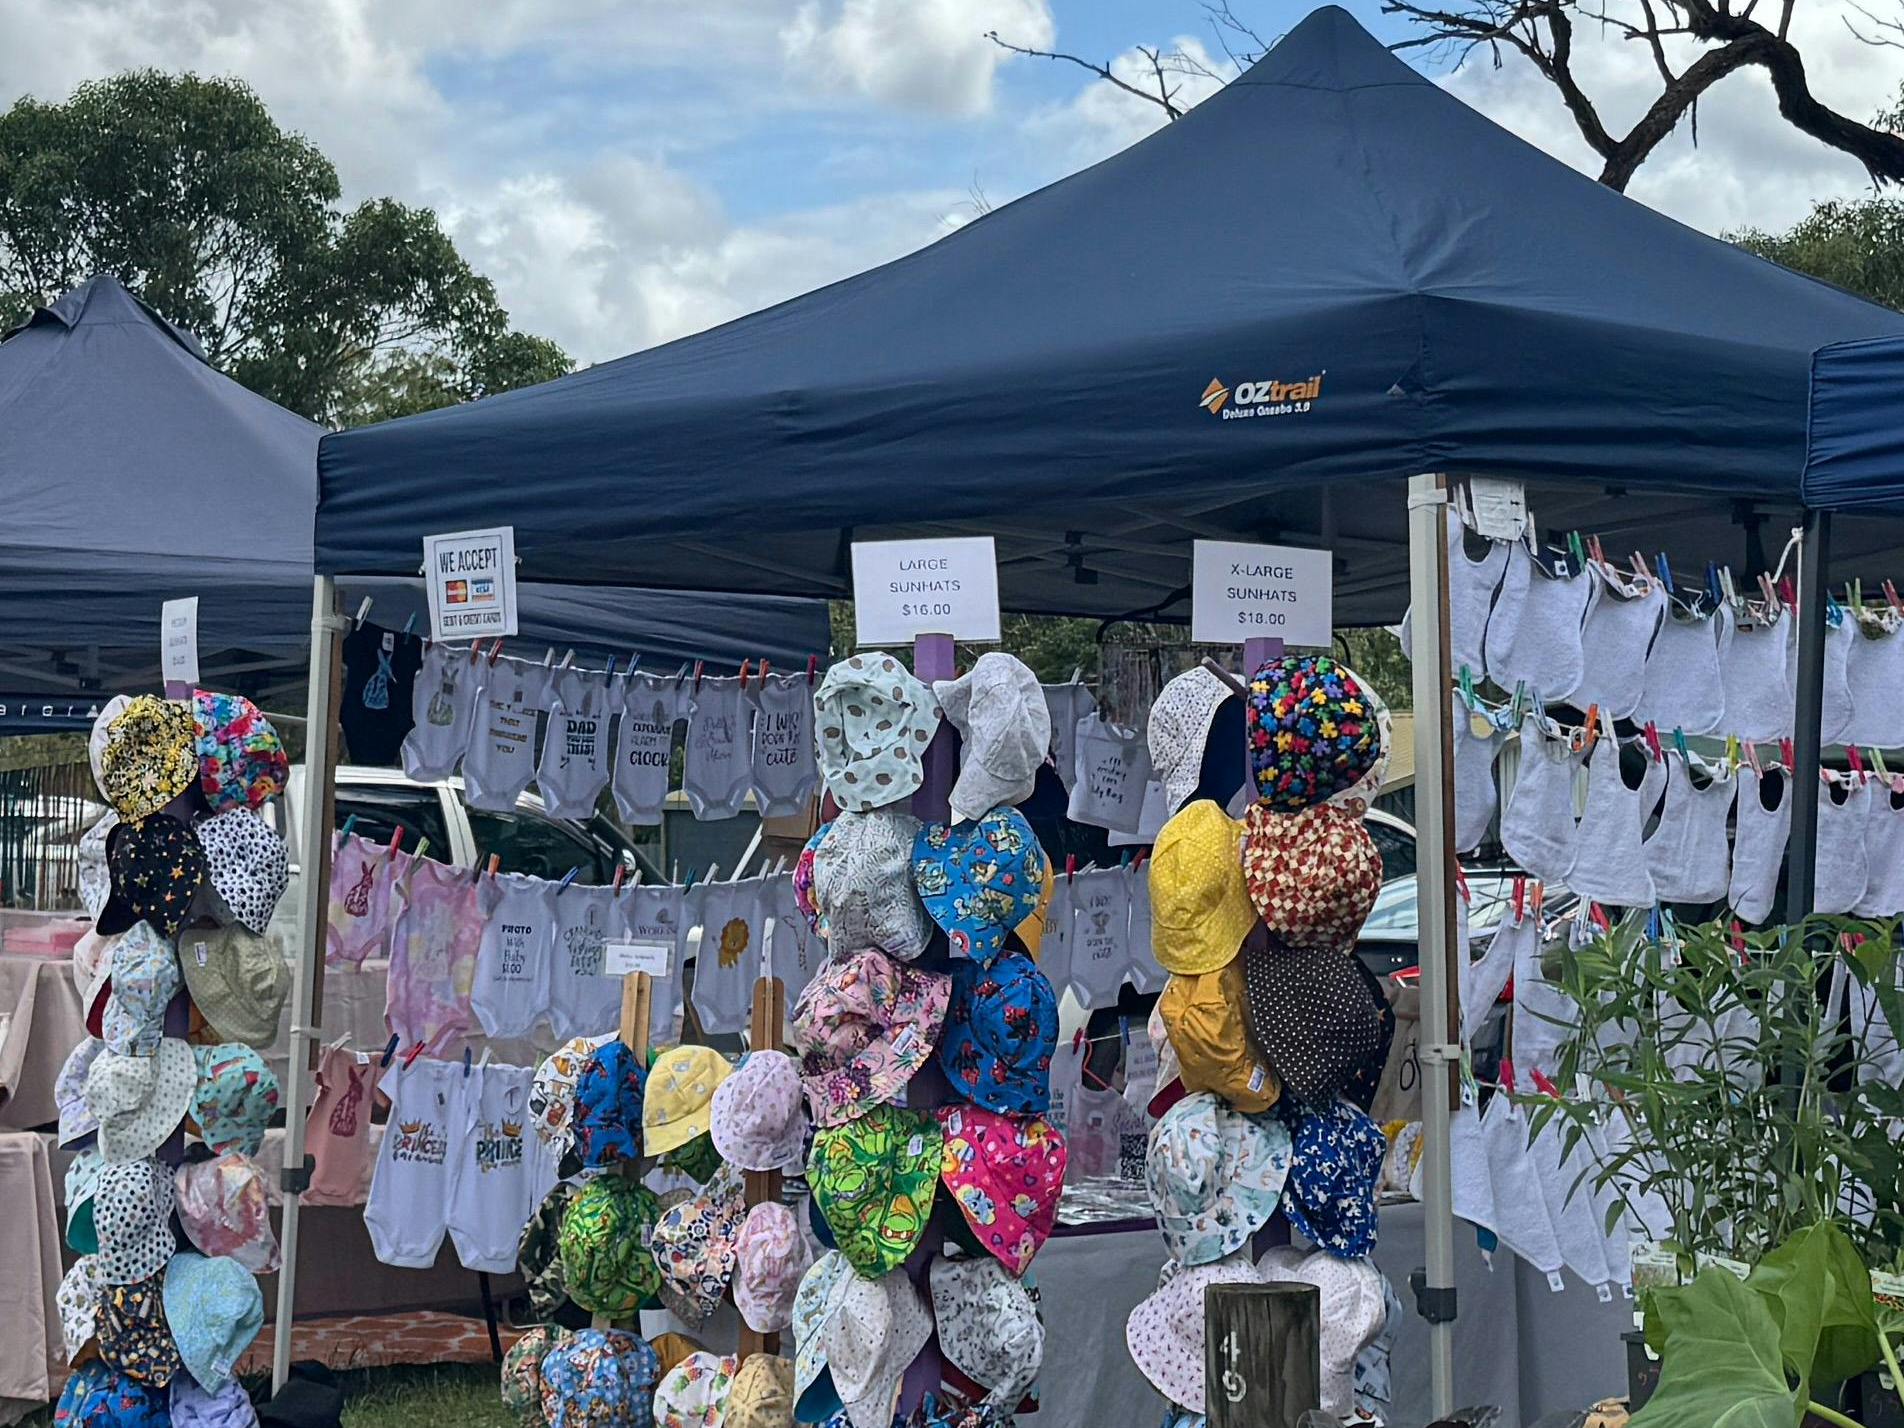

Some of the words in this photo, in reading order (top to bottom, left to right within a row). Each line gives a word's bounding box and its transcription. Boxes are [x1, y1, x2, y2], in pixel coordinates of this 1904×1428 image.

[1234, 375, 1321, 404] OZtrail
[439, 551, 455, 573] WE
[458, 548, 497, 572] ACCEPT
[899, 559, 948, 571] LARGE
[1231, 563, 1293, 579] X-LARGE
[890, 580, 961, 593] SUNHATS
[1227, 587, 1296, 602] SUNHATS
[902, 603, 951, 616] $16.00
[1238, 612, 1286, 625] $18.00
[566, 720, 596, 734] DAD
